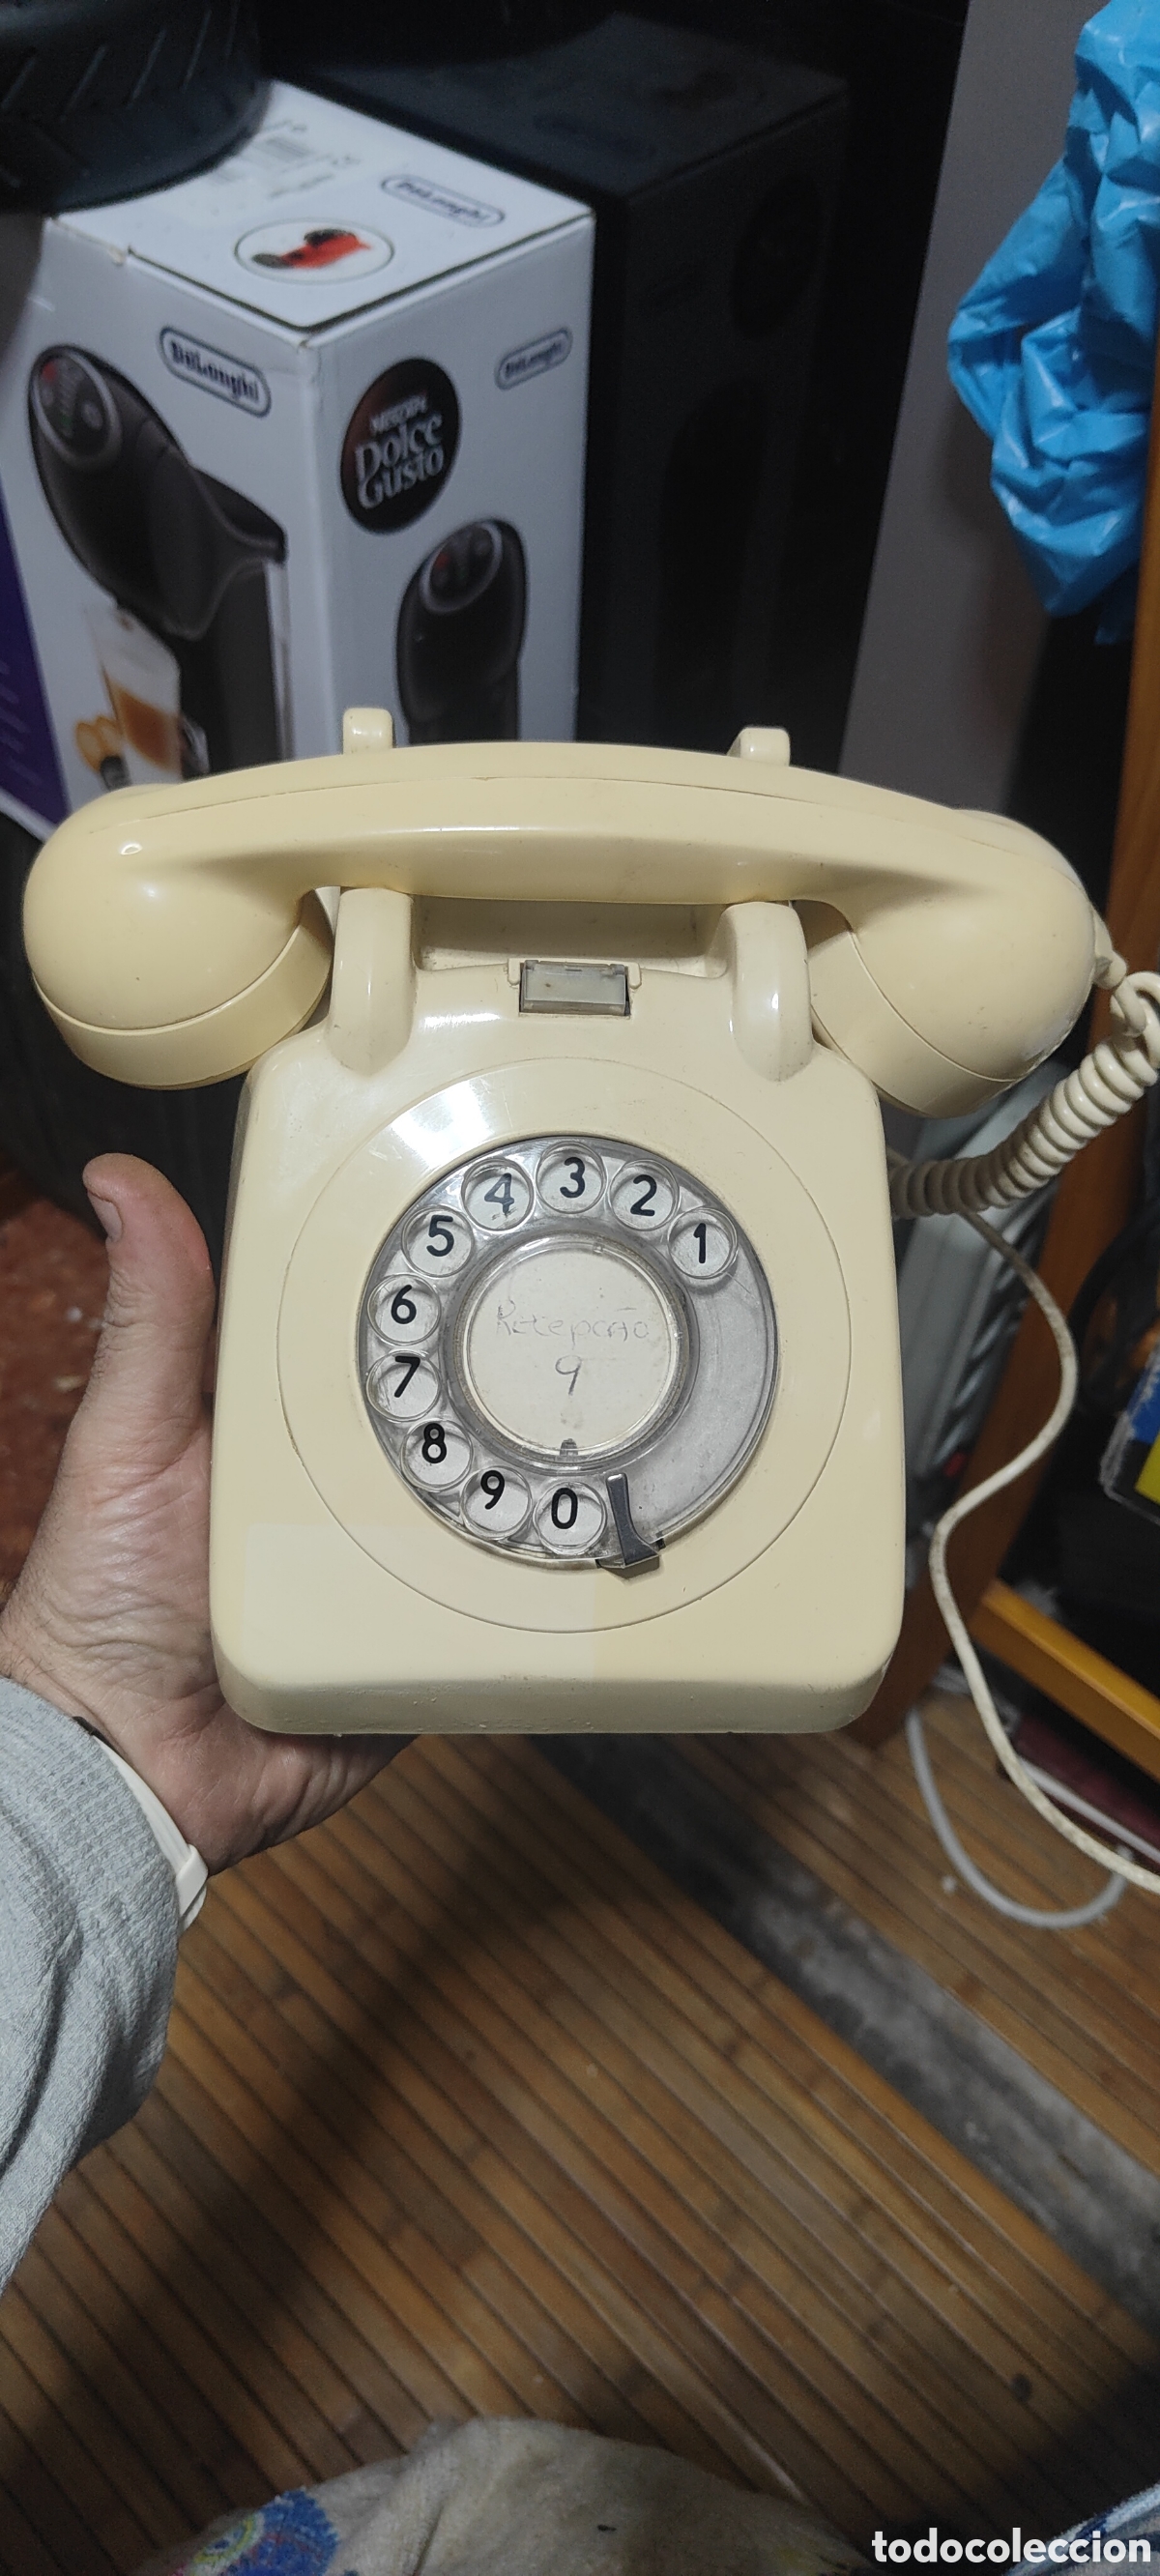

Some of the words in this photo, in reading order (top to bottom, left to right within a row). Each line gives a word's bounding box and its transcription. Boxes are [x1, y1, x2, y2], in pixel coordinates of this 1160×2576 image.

[355, 410, 445, 481] Dolce
[483, 1172, 515, 1216] 4
[560, 1156, 586, 1199] 3
[630, 1173, 657, 1217] 2
[426, 1214, 454, 1258] 5
[693, 1222, 707, 1264] 1
[391, 1284, 417, 1325] 6
[393, 1355, 421, 1399] 7
[554, 1354, 583, 1395] 9
[421, 1422, 448, 1464] 8
[479, 1469, 506, 1510] 9
[551, 1487, 578, 1530] 0
